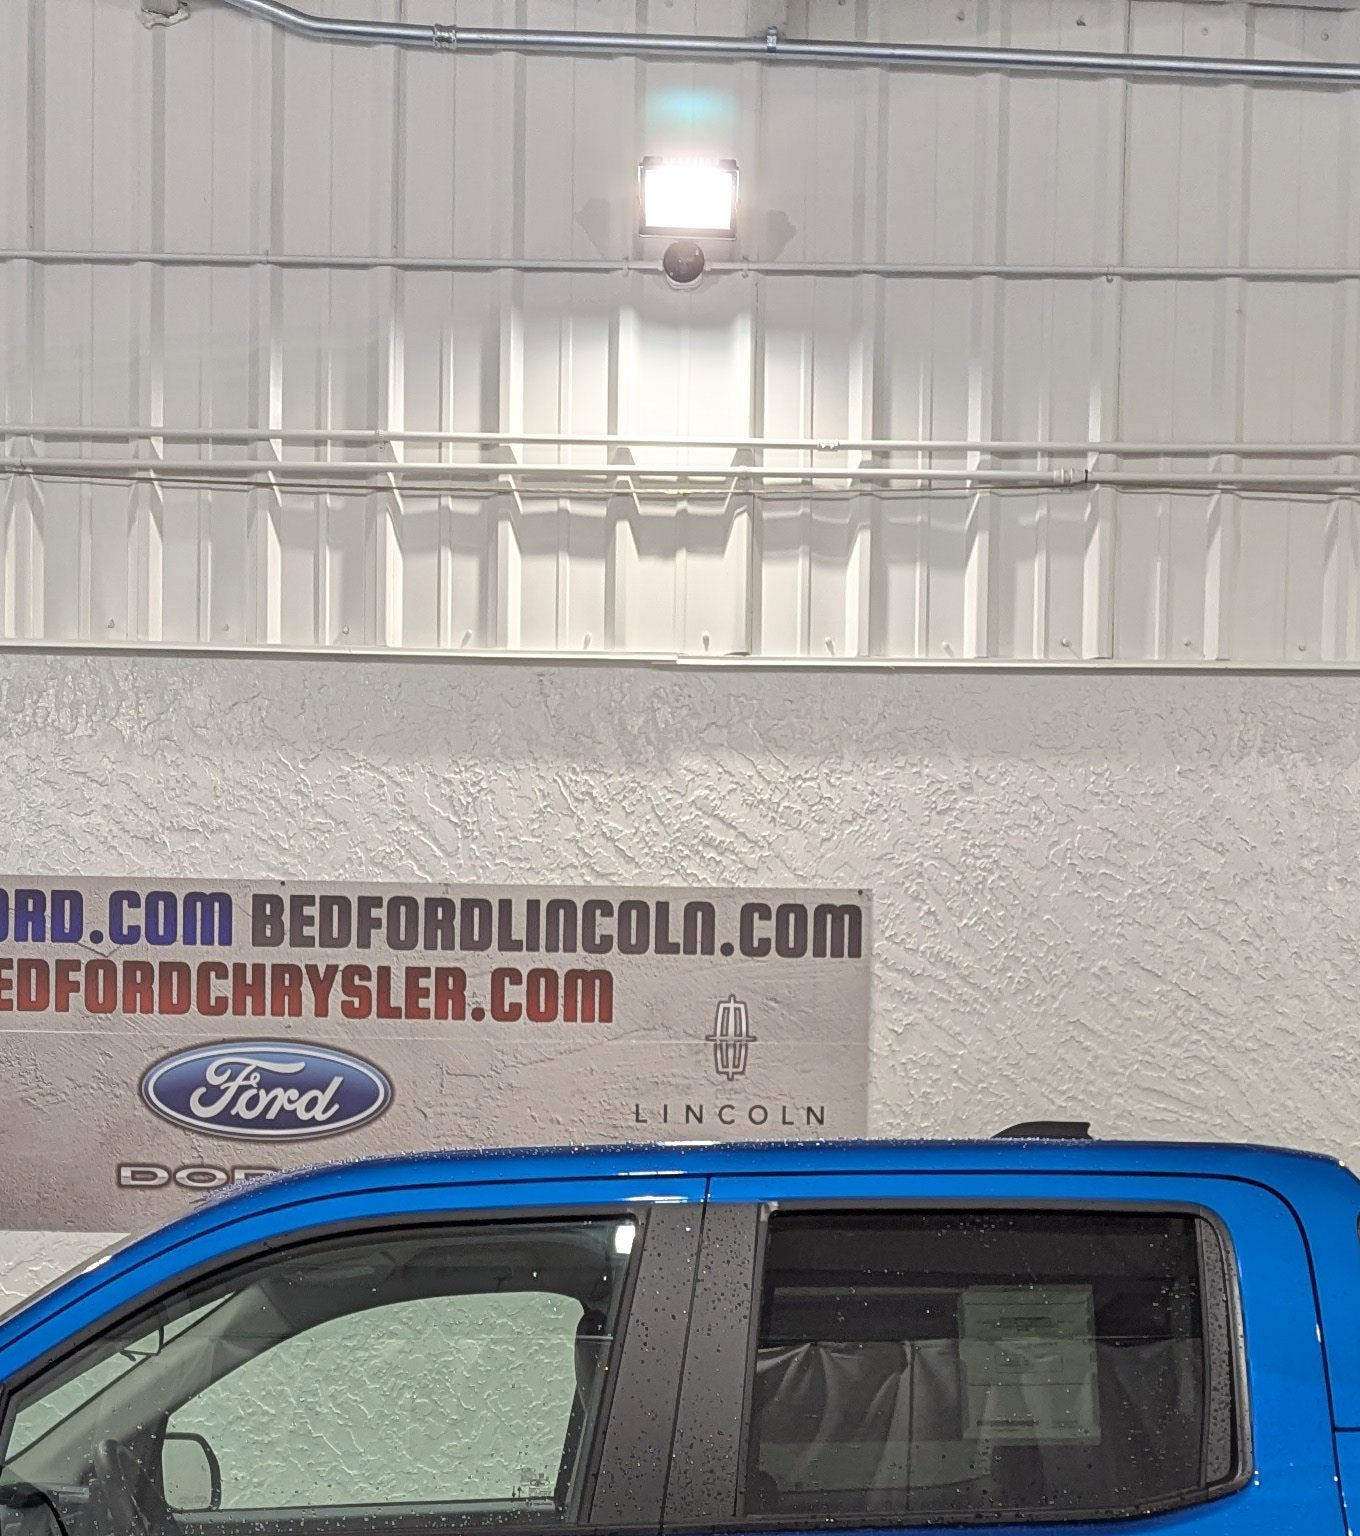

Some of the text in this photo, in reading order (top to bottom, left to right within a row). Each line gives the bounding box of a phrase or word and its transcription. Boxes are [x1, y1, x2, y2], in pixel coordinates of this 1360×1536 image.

[251, 893, 863, 959] BEDFORDLINCOLN.COM
[188, 1055, 344, 1122] Ford
[634, 1103, 826, 1127] LINCOLN
